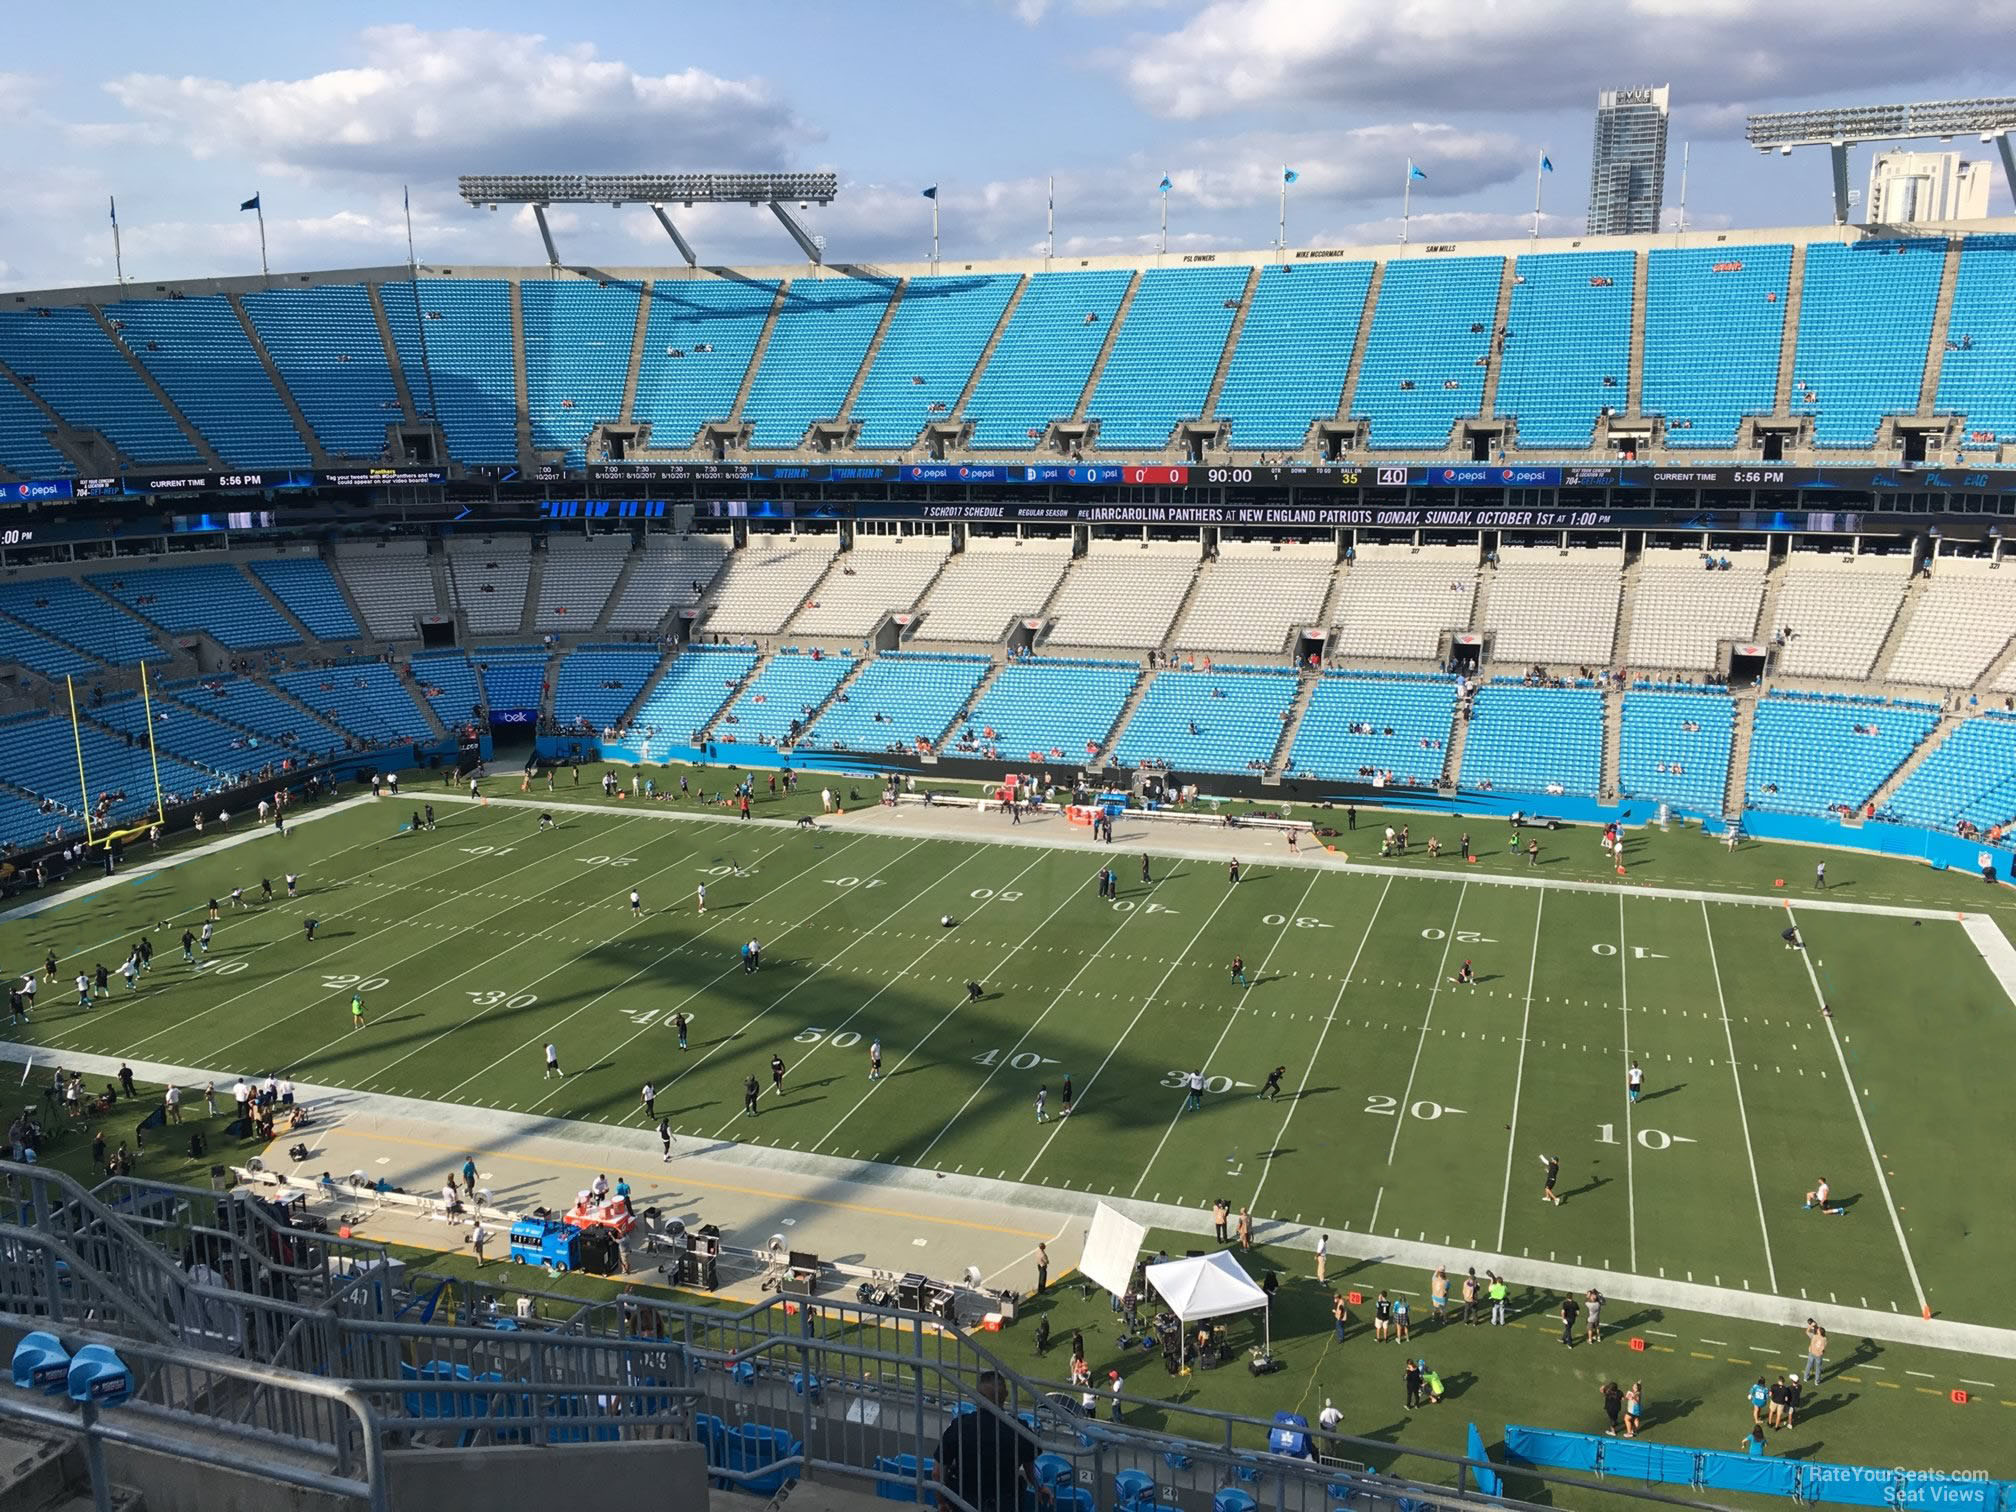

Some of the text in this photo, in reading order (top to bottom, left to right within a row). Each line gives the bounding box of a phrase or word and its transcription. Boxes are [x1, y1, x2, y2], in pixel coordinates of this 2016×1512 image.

[1626, 90, 1650, 99] VUE
[1295, 249, 1344, 258] MIKE MCCORMACK
[1425, 245, 1438, 253] SAM
[1183, 254, 1216, 263] PSL OWNERS
[428, 472, 441, 480] they
[626, 472, 656, 480] 8/10/2017
[662, 472, 691, 480] 8/10/2017
[725, 472, 754, 480] 8/10/2017
[924, 469, 947, 480] pepsi
[971, 469, 995, 480] pepsi
[1170, 470, 1179, 482] 0
[1208, 469, 1252, 483] 90:00
[1342, 473, 1358, 485] 35
[1382, 470, 1403, 483] 40
[1458, 471, 1486, 481] pepsi
[1517, 471, 1545, 481] pepsi
[1653, 473, 1717, 482] CURRENT TIME
[1734, 472, 1784, 483] 5:56 PM
[150, 478, 206, 489] CURRENT TIME
[219, 475, 262, 486] 5:56 PM
[32, 485, 58, 496] pepsi
[964, 507, 1005, 518] SCHEDULE
[1018, 509, 1068, 518] REGULAR SEASON
[1169, 508, 1223, 521] PANTHERS
[1225, 510, 1237, 521] AT
[1239, 509, 1264, 522] NEW
[1267, 510, 1316, 523] ENGLAND
[1319, 510, 1373, 524] PATRIOTS
[1425, 511, 1472, 526] SUNDAY,
[1476, 511, 1532, 525] OCTOBER
[1536, 513, 1553, 525] 1ST
[1556, 515, 1566, 523] AT
[1570, 512, 1597, 525] 1:00
[1598, 515, 1611, 524] PM
[21, 531, 33, 541] PM
[1842, 556, 1855, 564] 320
[1988, 562, 2001, 570] 321
[333, 973, 391, 993] 20
[472, 989, 538, 1011] 30
[630, 1008, 696, 1030] 40
[793, 1026, 862, 1049] 50
[971, 1047, 1042, 1071] 40
[1159, 1069, 1237, 1095] 30
[1364, 1094, 1443, 1122] 20
[1594, 1122, 1672, 1151] 10
